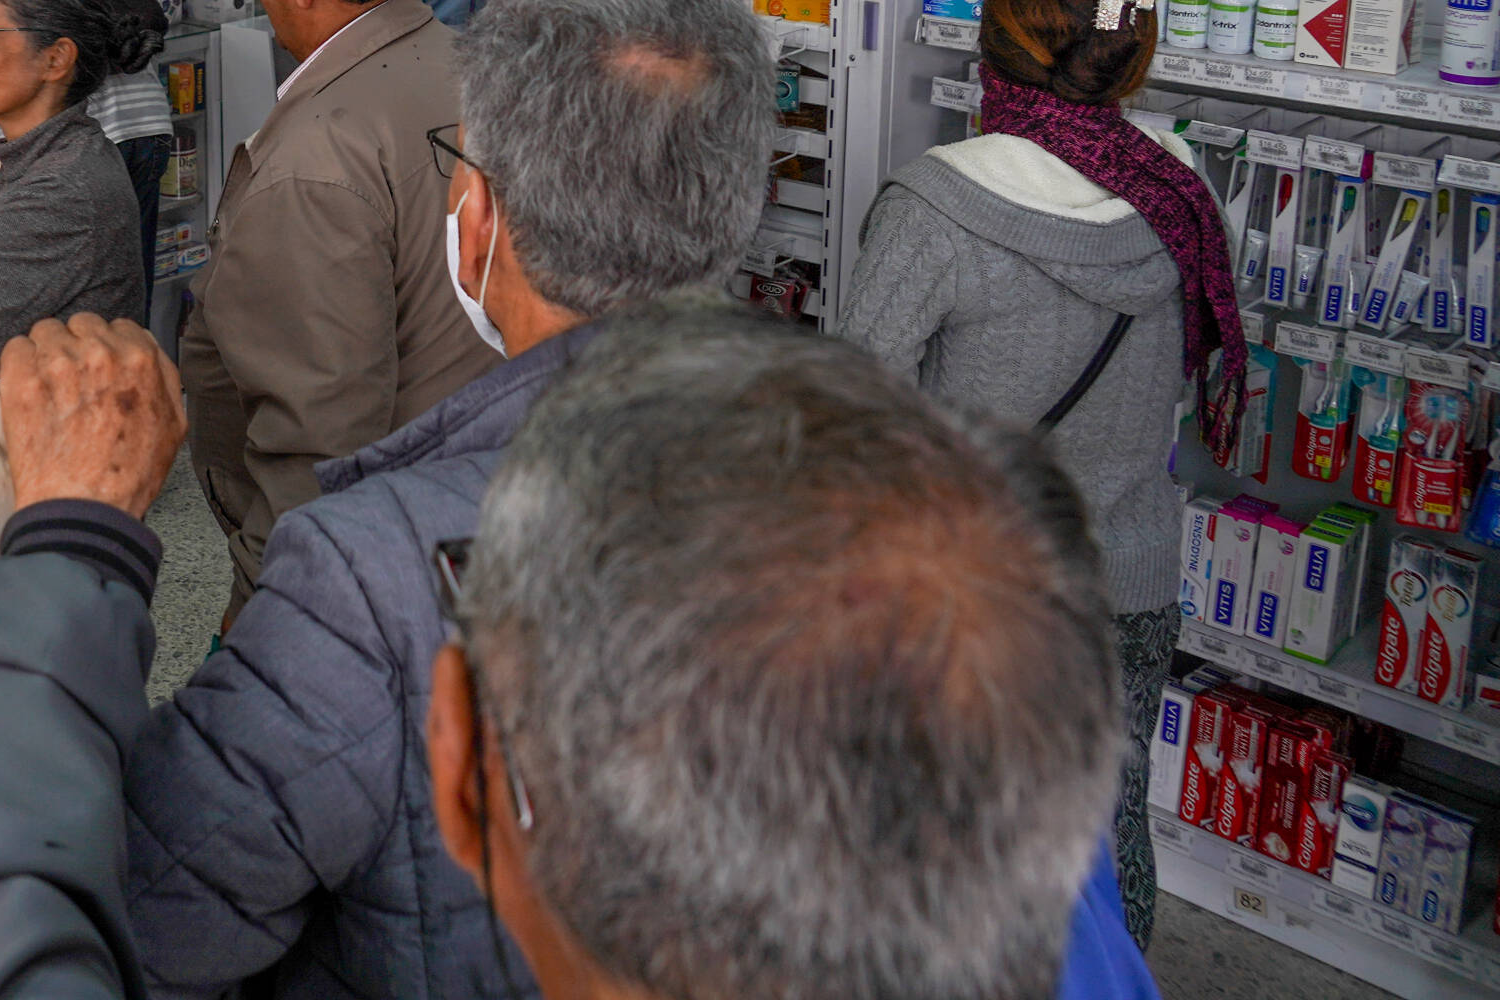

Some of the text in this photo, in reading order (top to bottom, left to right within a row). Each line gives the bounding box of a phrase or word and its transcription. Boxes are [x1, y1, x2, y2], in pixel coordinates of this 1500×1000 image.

[1212, 20, 1238, 29] K-trix
[1271, 270, 1283, 298] VITIS
[1327, 288, 1340, 321] VITIS
[1367, 292, 1384, 323] VITIS
[1436, 294, 1446, 327] VITIS
[1473, 308, 1485, 342] VITIS
[1305, 427, 1317, 461] Colgate
[1365, 450, 1377, 485] Colgate
[1413, 470, 1426, 509] Colgate
[1189, 514, 1204, 573] SENSODYNE
[1310, 549, 1324, 588] VITIS
[1218, 584, 1232, 621] VITIS
[1259, 596, 1274, 634] VITIS
[1377, 616, 1400, 683] Colgate
[1421, 632, 1444, 698] Colgate
[1165, 705, 1178, 741] VITIS
[1181, 760, 1200, 821] Colgate
[1218, 778, 1237, 837] Colgate
[1298, 815, 1317, 868] Colgate
[1240, 893, 1262, 913] 82
